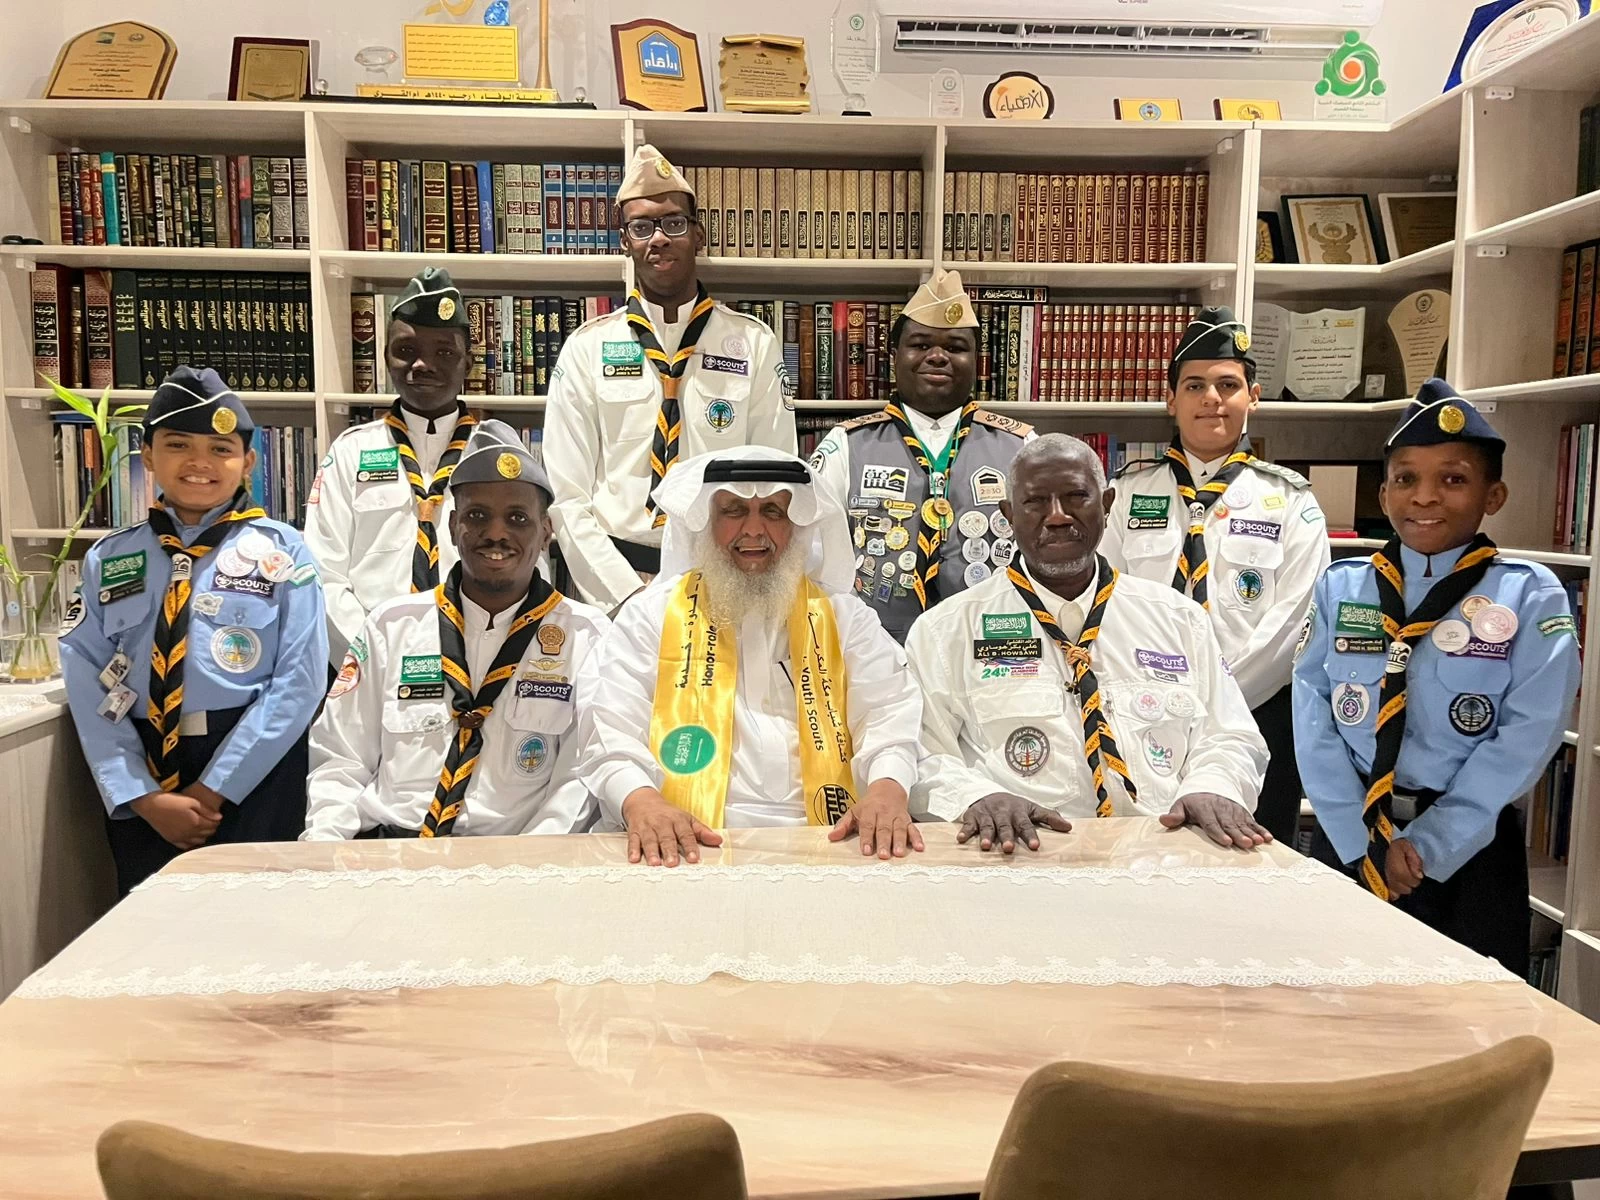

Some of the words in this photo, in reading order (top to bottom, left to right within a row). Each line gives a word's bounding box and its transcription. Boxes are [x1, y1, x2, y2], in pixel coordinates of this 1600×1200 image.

[717, 360, 744, 369] SCOUTS
[1246, 523, 1276, 534] SCOUTS
[232, 578, 270, 591] SCOUTS
[1470, 642, 1505, 653] SCOUTS
[1150, 655, 1183, 666] SCOUTS
[981, 666, 1010, 680] 24th
[533, 685, 568, 695] SCOUTS
[806, 708, 824, 751] Scouts
